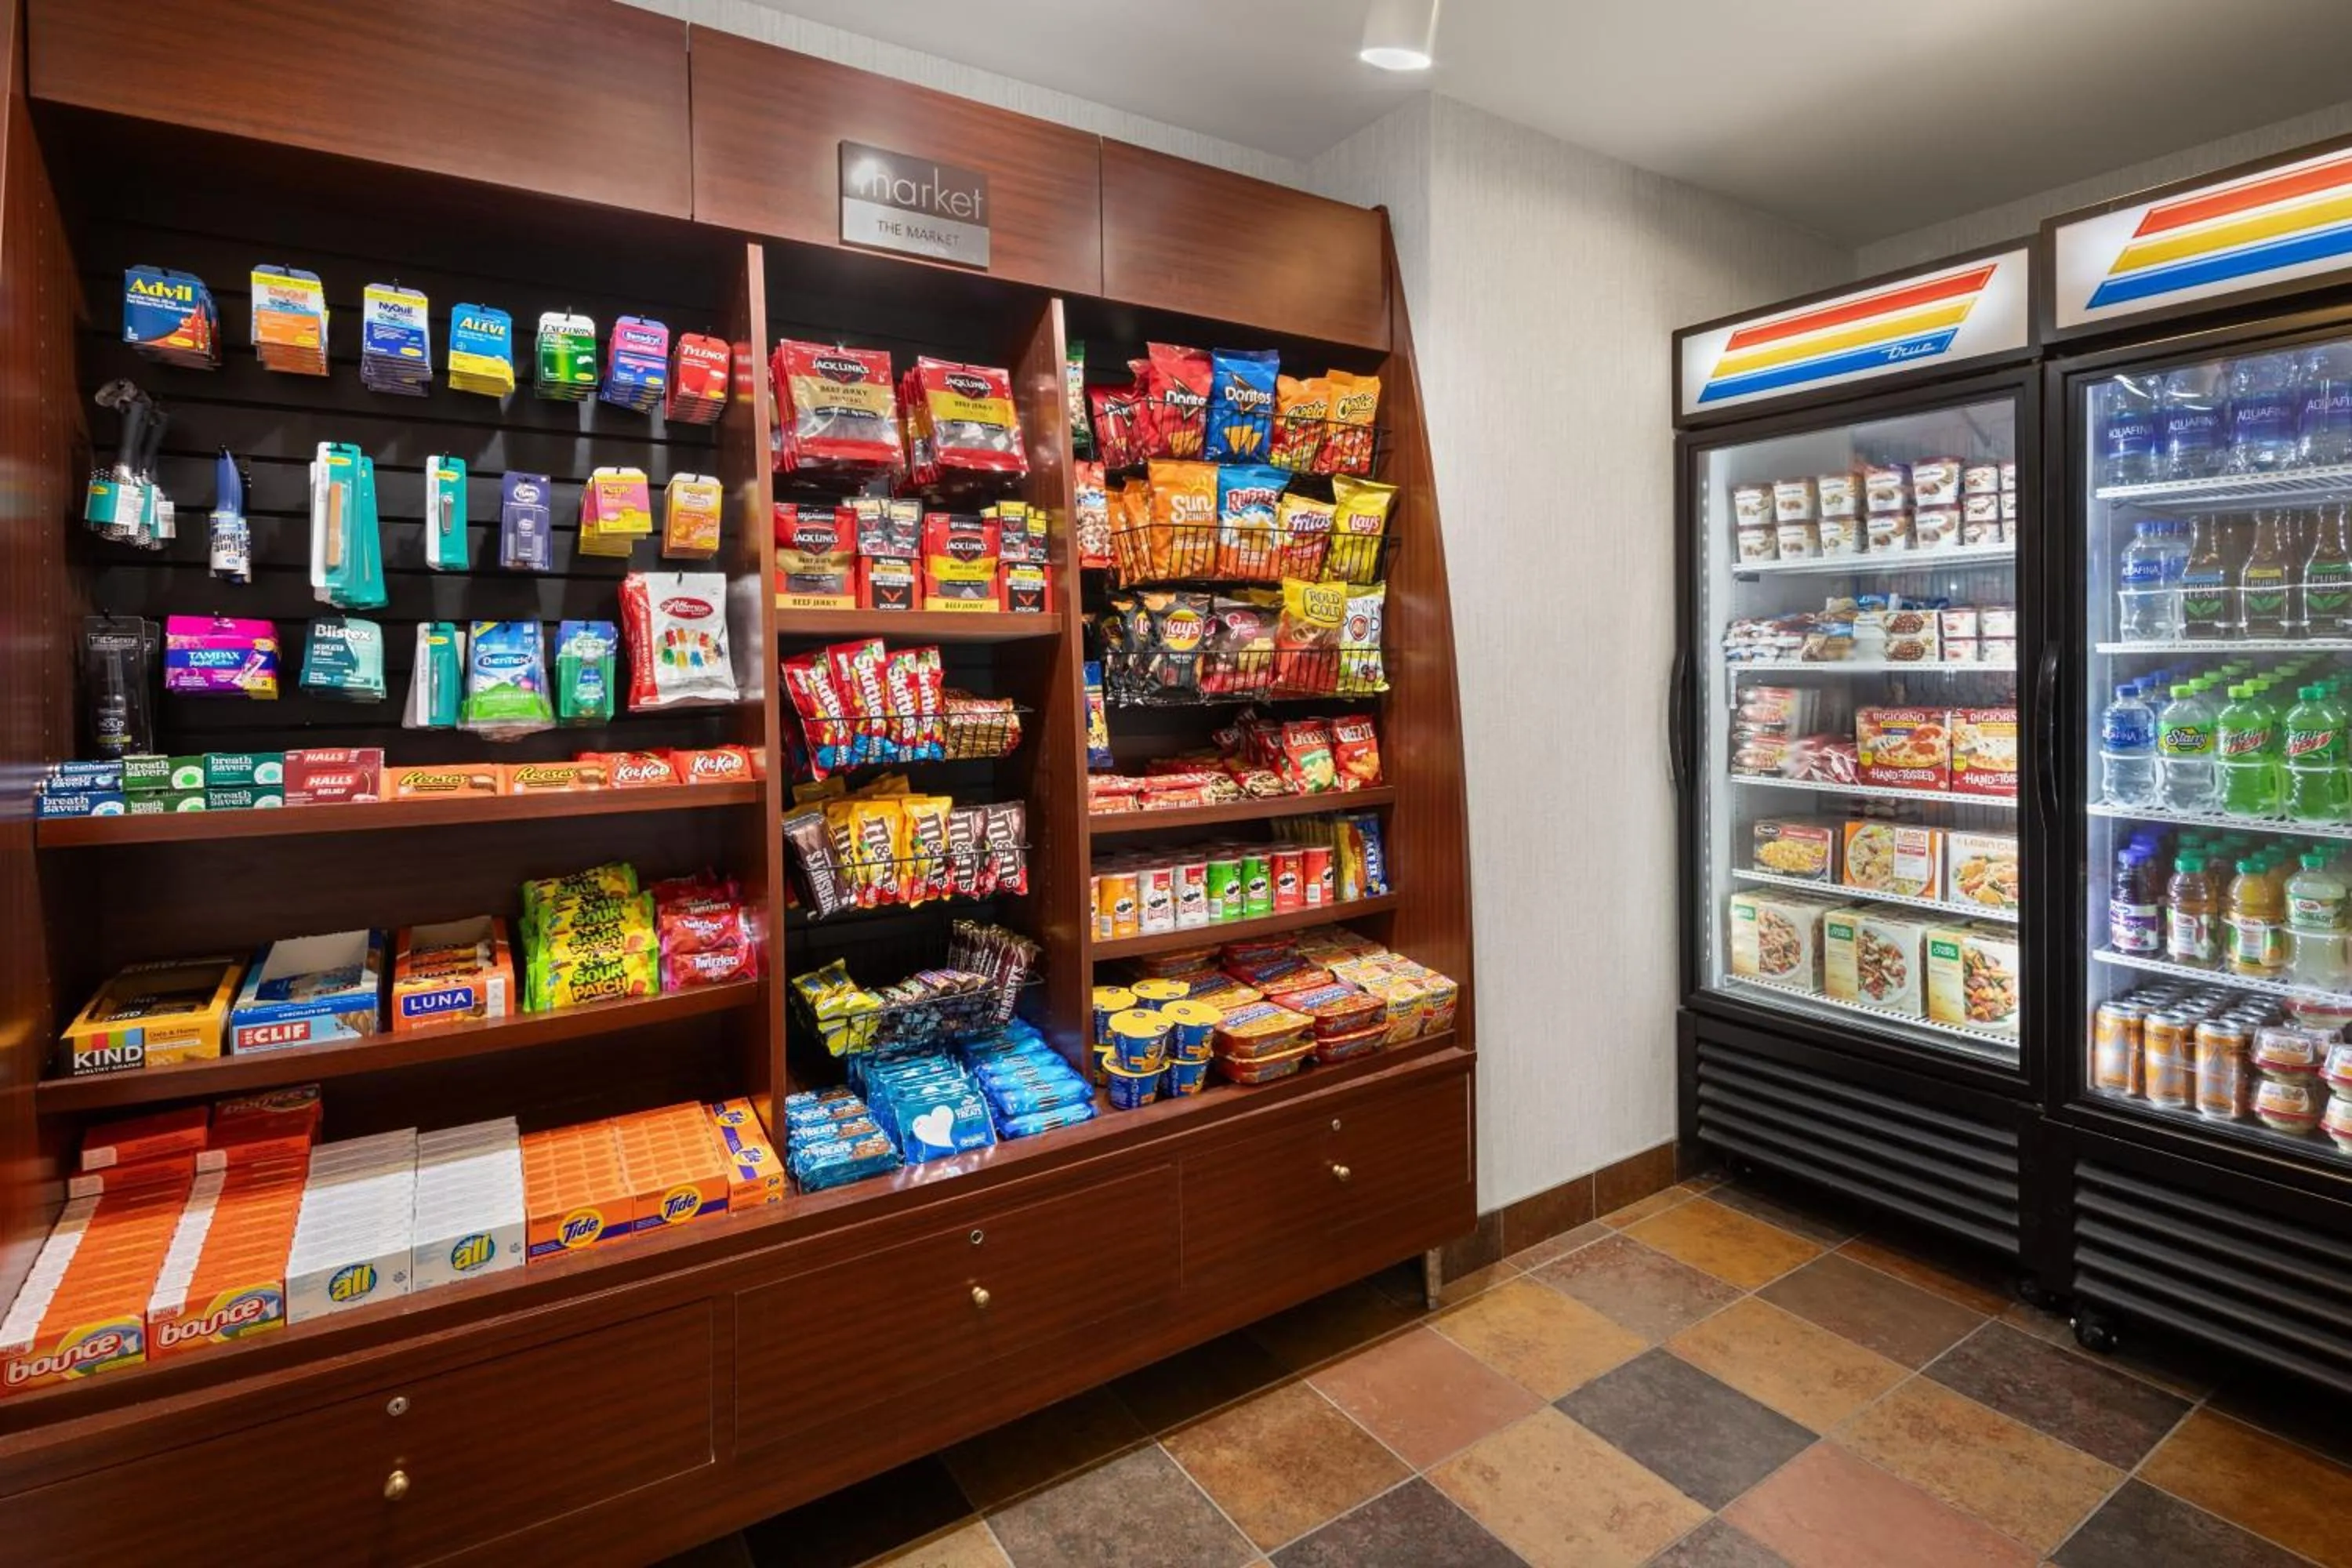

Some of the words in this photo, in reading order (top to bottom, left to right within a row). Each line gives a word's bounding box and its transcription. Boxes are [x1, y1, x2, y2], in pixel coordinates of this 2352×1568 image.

[877, 220, 902, 236] THE
[906, 225, 960, 245] MARKET
[129, 278, 193, 302] Advil
[379, 300, 413, 314] NyQuil
[459, 316, 506, 337] ALEVE
[683, 344, 728, 362] TYLENOL
[1882, 343, 1936, 359] true
[1166, 390, 1206, 406] Dorito
[1225, 387, 1271, 405] Doritos
[2306, 394, 2352, 413] AQUAFI
[1171, 494, 1211, 523] Sun
[1226, 488, 1276, 511] RUFFLE
[1351, 514, 1380, 532] Lay's
[792, 598, 811, 607] BEEF
[813, 598, 838, 607] JERKY
[1309, 590, 1340, 604] ROLD
[1311, 603, 1341, 617] GOLD
[315, 624, 372, 641] Blistex
[1166, 618, 1201, 640] Lay's
[188, 652, 240, 660] TAMPAX
[854, 653, 883, 730] Skittles
[887, 666, 918, 739] Skittles
[1970, 713, 2017, 722] DIGIORN
[125, 760, 169, 770] breath
[211, 755, 252, 765] breath
[305, 753, 345, 762] HALLS
[126, 768, 169, 777] savers
[211, 762, 252, 772] savers
[515, 765, 575, 782] Reese's
[309, 775, 353, 786] HALLS
[209, 790, 252, 800] breath
[317, 787, 346, 796] RELIEF
[43, 796, 89, 806] breath
[43, 803, 89, 813] savers
[130, 800, 164, 810] breath
[210, 797, 252, 807] savers
[571, 906, 620, 926] SOUR
[572, 964, 624, 984] SOUR
[572, 980, 628, 1001] PATCH
[410, 992, 467, 1011] LUNA
[254, 1024, 305, 1043] CLIF
[74, 1045, 143, 1069] KIND
[956, 1106, 982, 1119] TREATS
[664, 1193, 697, 1218] Tide
[562, 1218, 599, 1243] Tide
[452, 1232, 492, 1270] all
[330, 1264, 373, 1301] all
[161, 1298, 261, 1346] bounce
[7, 1334, 120, 1385] bounce
